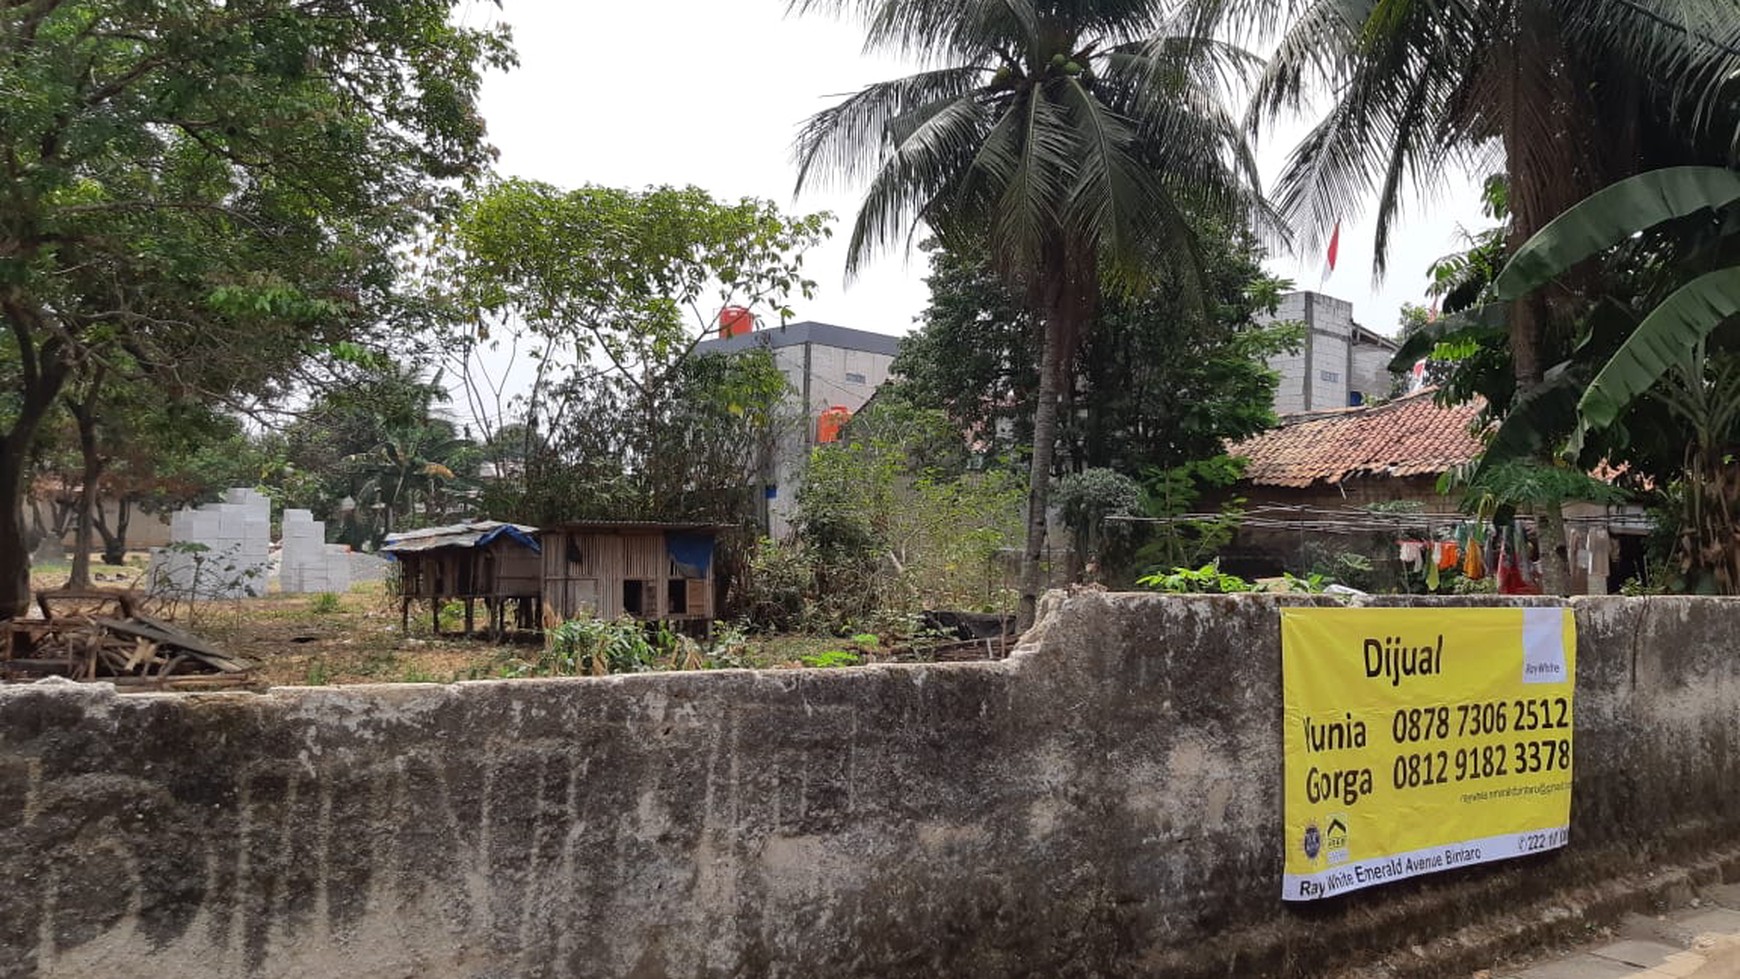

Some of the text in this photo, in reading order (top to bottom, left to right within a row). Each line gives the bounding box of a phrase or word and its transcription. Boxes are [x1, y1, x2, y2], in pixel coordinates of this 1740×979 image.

[1363, 633, 1443, 687] Dijual
[1303, 698, 1569, 753] Yunia 0878 7306 2512
[1306, 739, 1570, 806] Gorga 0812 9182 3378
[1300, 880, 1325, 898] Ray
[1326, 871, 1354, 891] White
[1354, 858, 1403, 883] Emerald
[1405, 857, 1444, 872] Avenue
